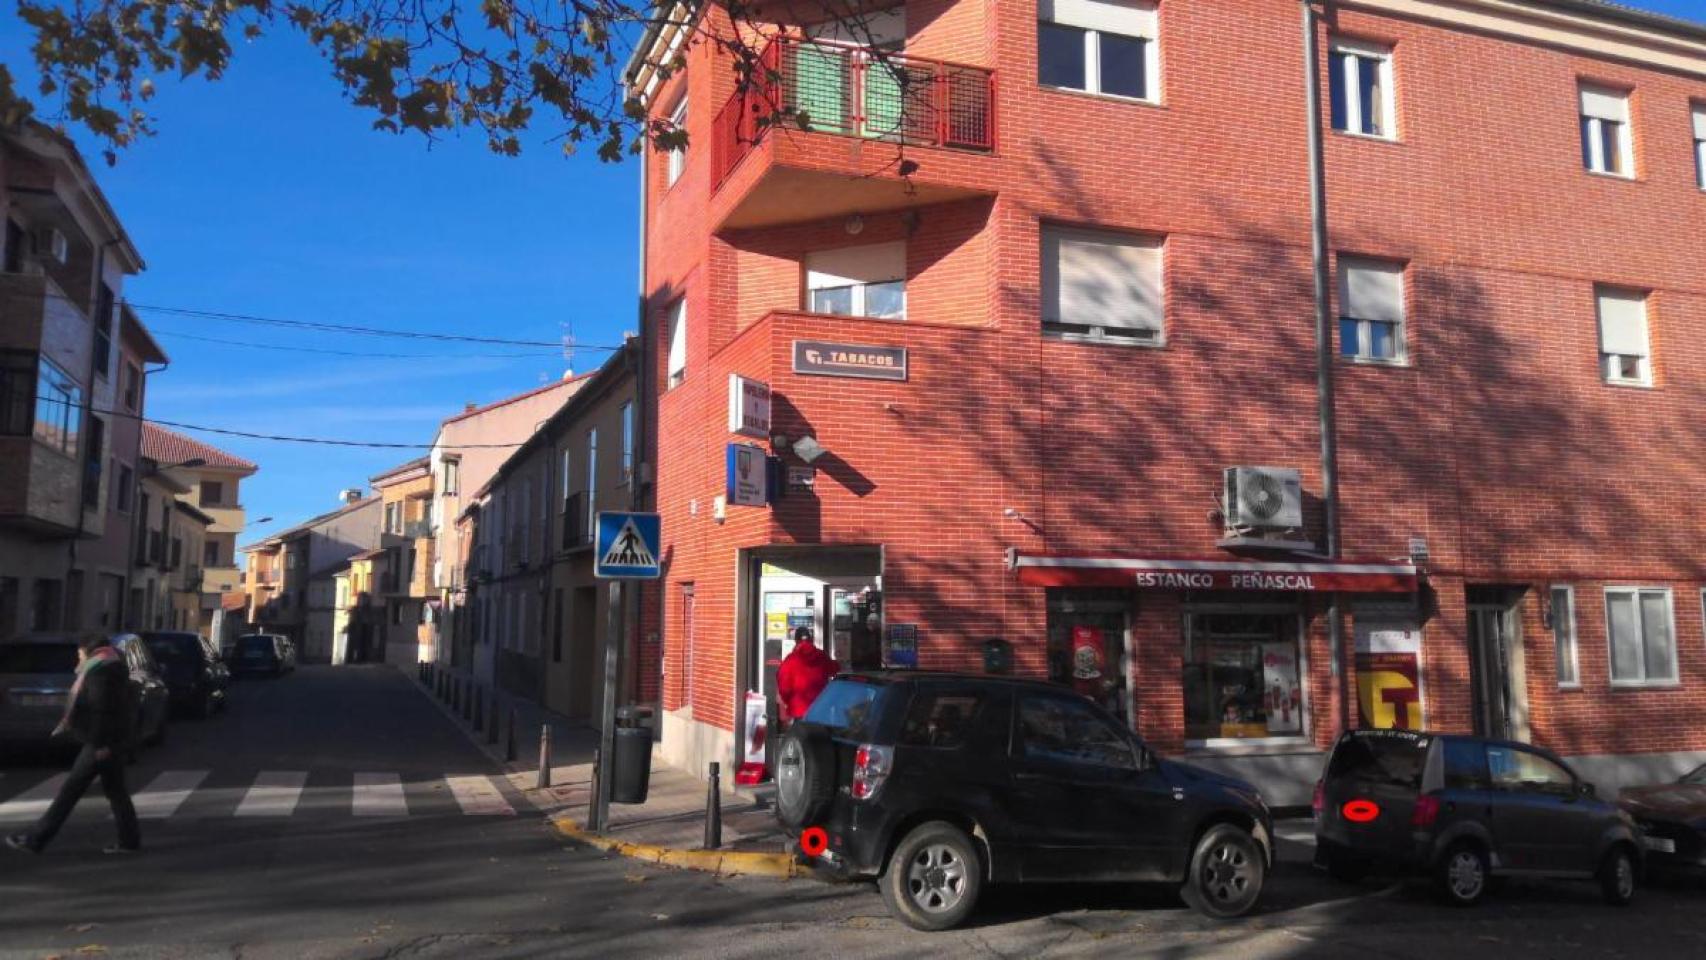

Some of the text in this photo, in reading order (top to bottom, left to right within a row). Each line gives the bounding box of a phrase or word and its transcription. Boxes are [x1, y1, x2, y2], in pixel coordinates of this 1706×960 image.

[830, 351, 893, 366] TABACOS
[1136, 572, 1315, 589] ESTANCO PEÑASCAL
